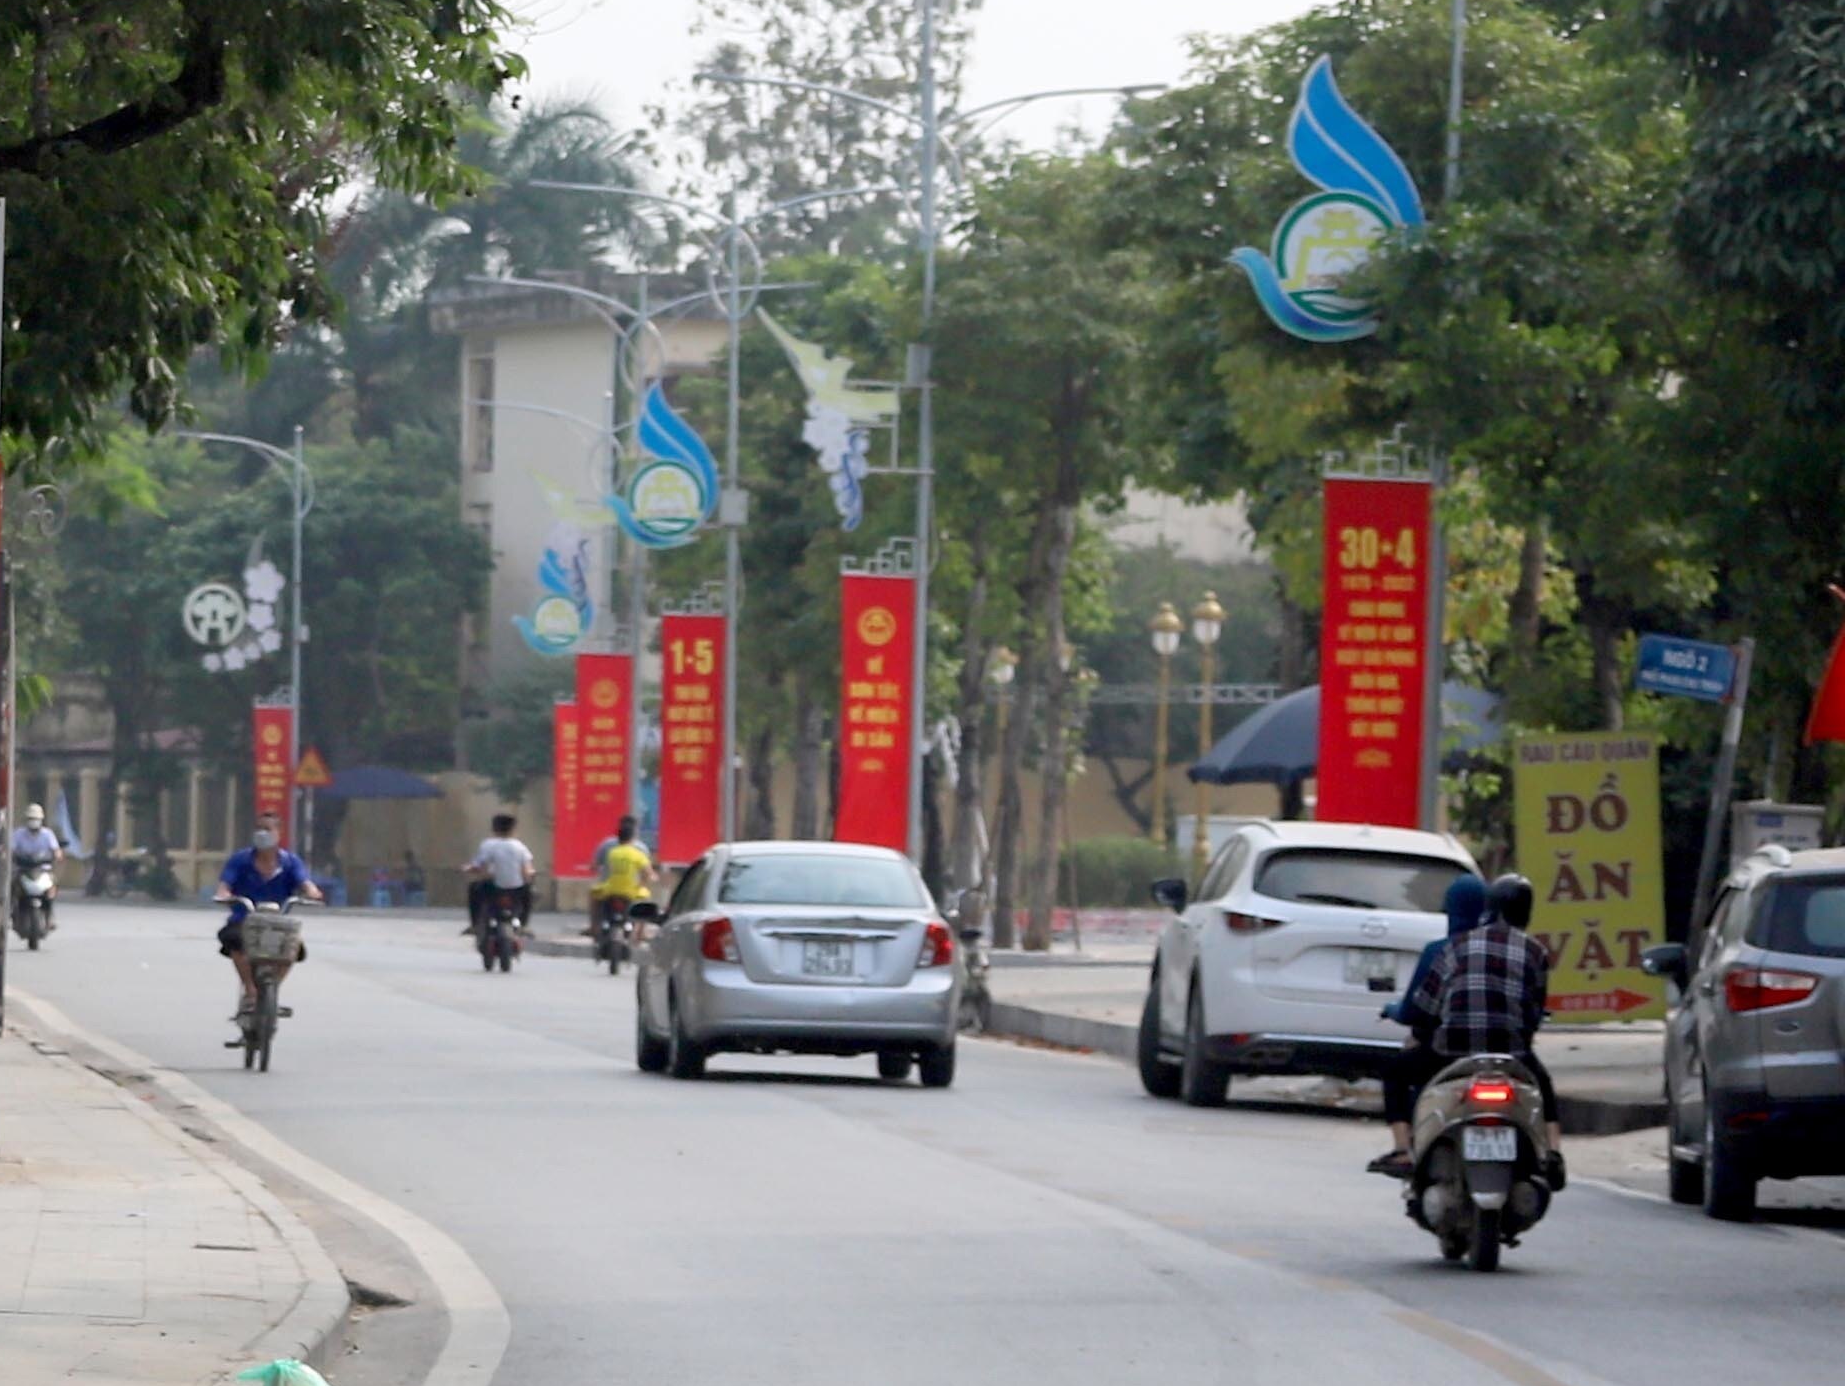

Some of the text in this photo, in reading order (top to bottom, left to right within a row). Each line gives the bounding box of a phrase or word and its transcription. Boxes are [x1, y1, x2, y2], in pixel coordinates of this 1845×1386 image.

[1545, 772, 1628, 835] ĐỒ
[1547, 851, 1633, 903] ĂN
[1535, 920, 1651, 982] VẶT
